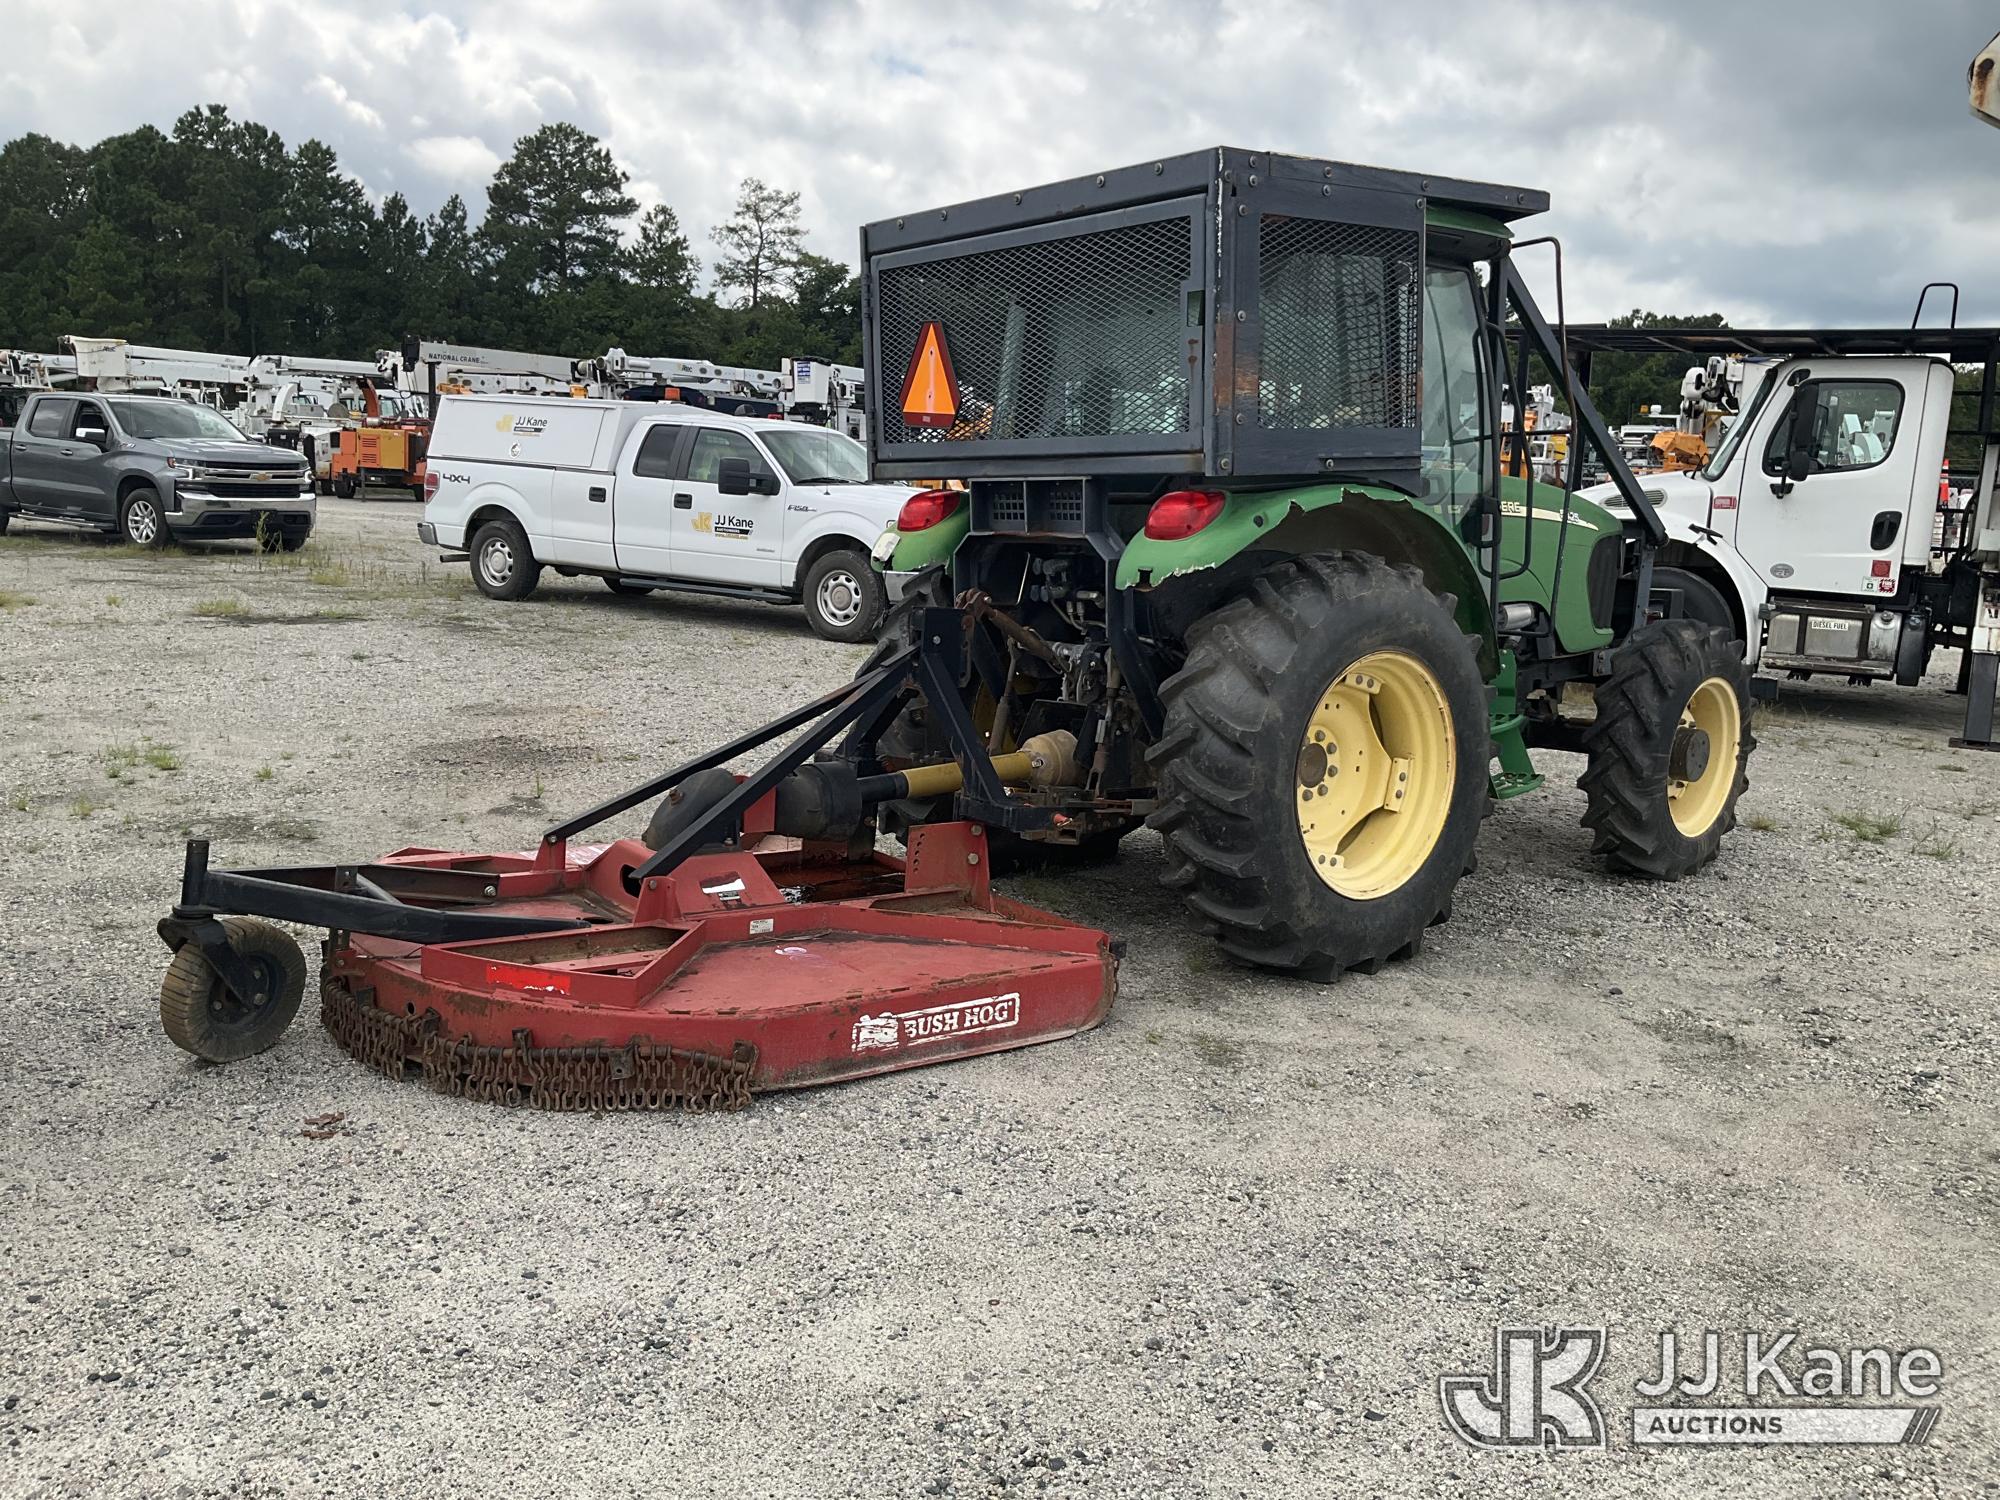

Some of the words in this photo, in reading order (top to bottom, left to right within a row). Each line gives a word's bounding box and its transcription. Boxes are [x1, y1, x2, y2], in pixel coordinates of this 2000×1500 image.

[428, 352, 459, 362] NATIONAL
[460, 355, 480, 364] CRANE
[515, 416, 526, 426] JJ
[527, 416, 548, 427] Kane
[1500, 501, 1521, 514] ERE
[715, 515, 726, 526] JJ
[728, 515, 754, 529] Kane
[1813, 621, 1832, 629] DIESEL
[1833, 622, 1847, 630] FUEL
[904, 1010, 959, 1038] BUSH
[964, 1001, 1009, 1028] HOG
